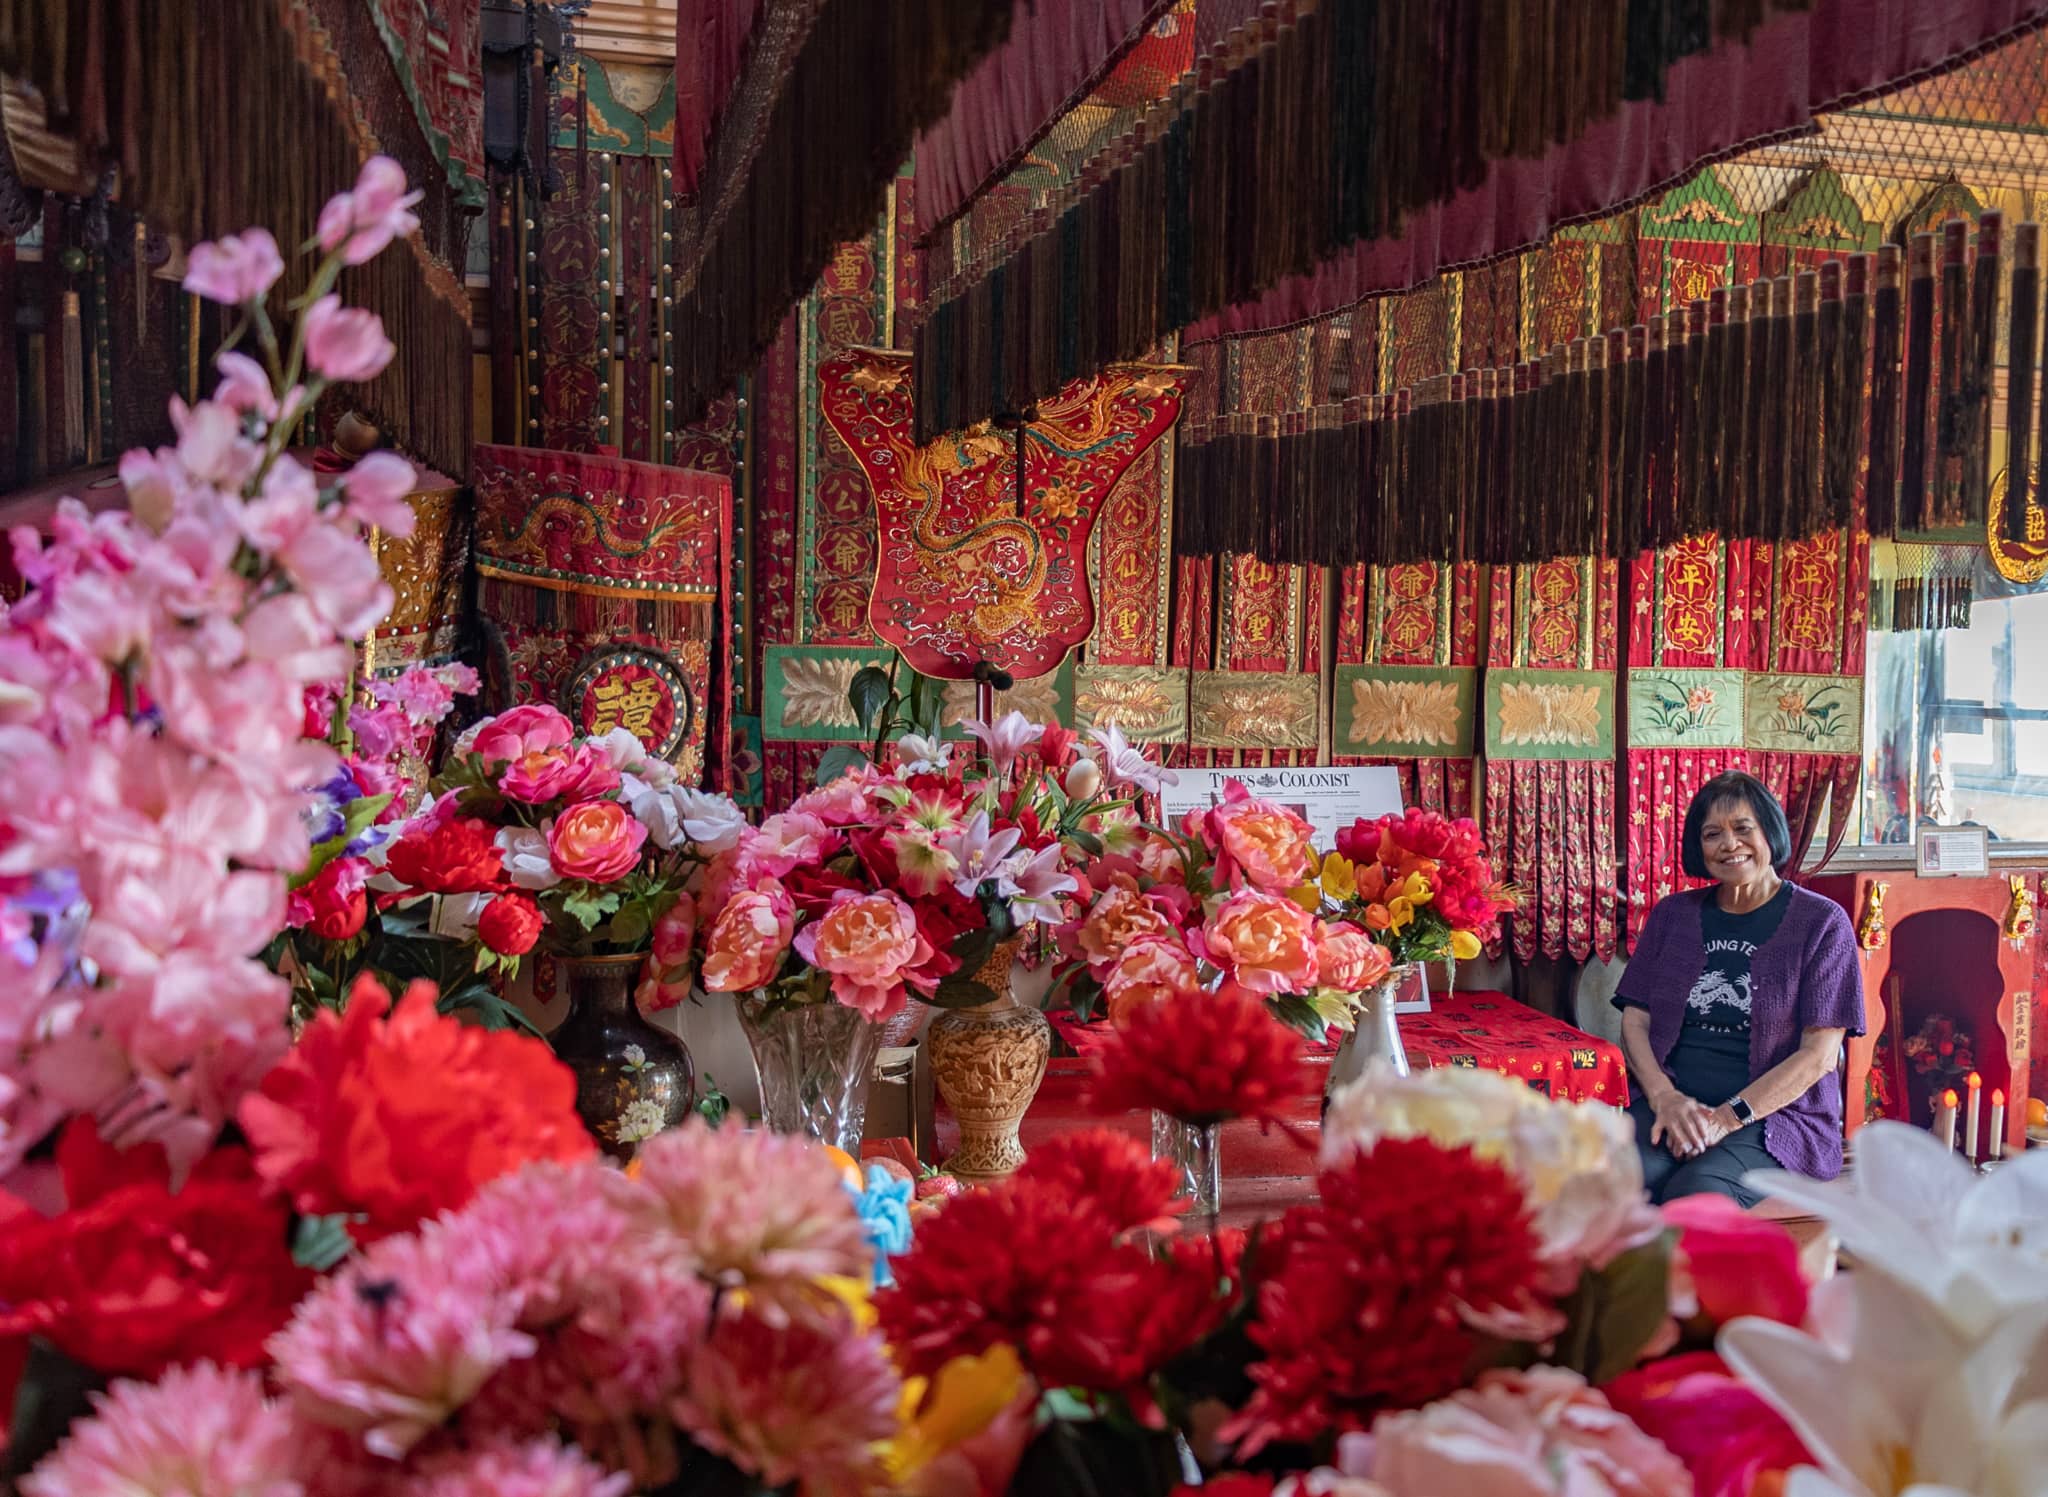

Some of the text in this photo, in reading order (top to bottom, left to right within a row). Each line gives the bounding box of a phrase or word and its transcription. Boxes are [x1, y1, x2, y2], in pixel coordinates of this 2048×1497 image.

[551, 172, 596, 453] 譚公爺爺
[1674, 564, 1705, 644] 平安
[1793, 564, 1822, 644] 平安
[1209, 771, 1350, 788] TIES COLONIST
